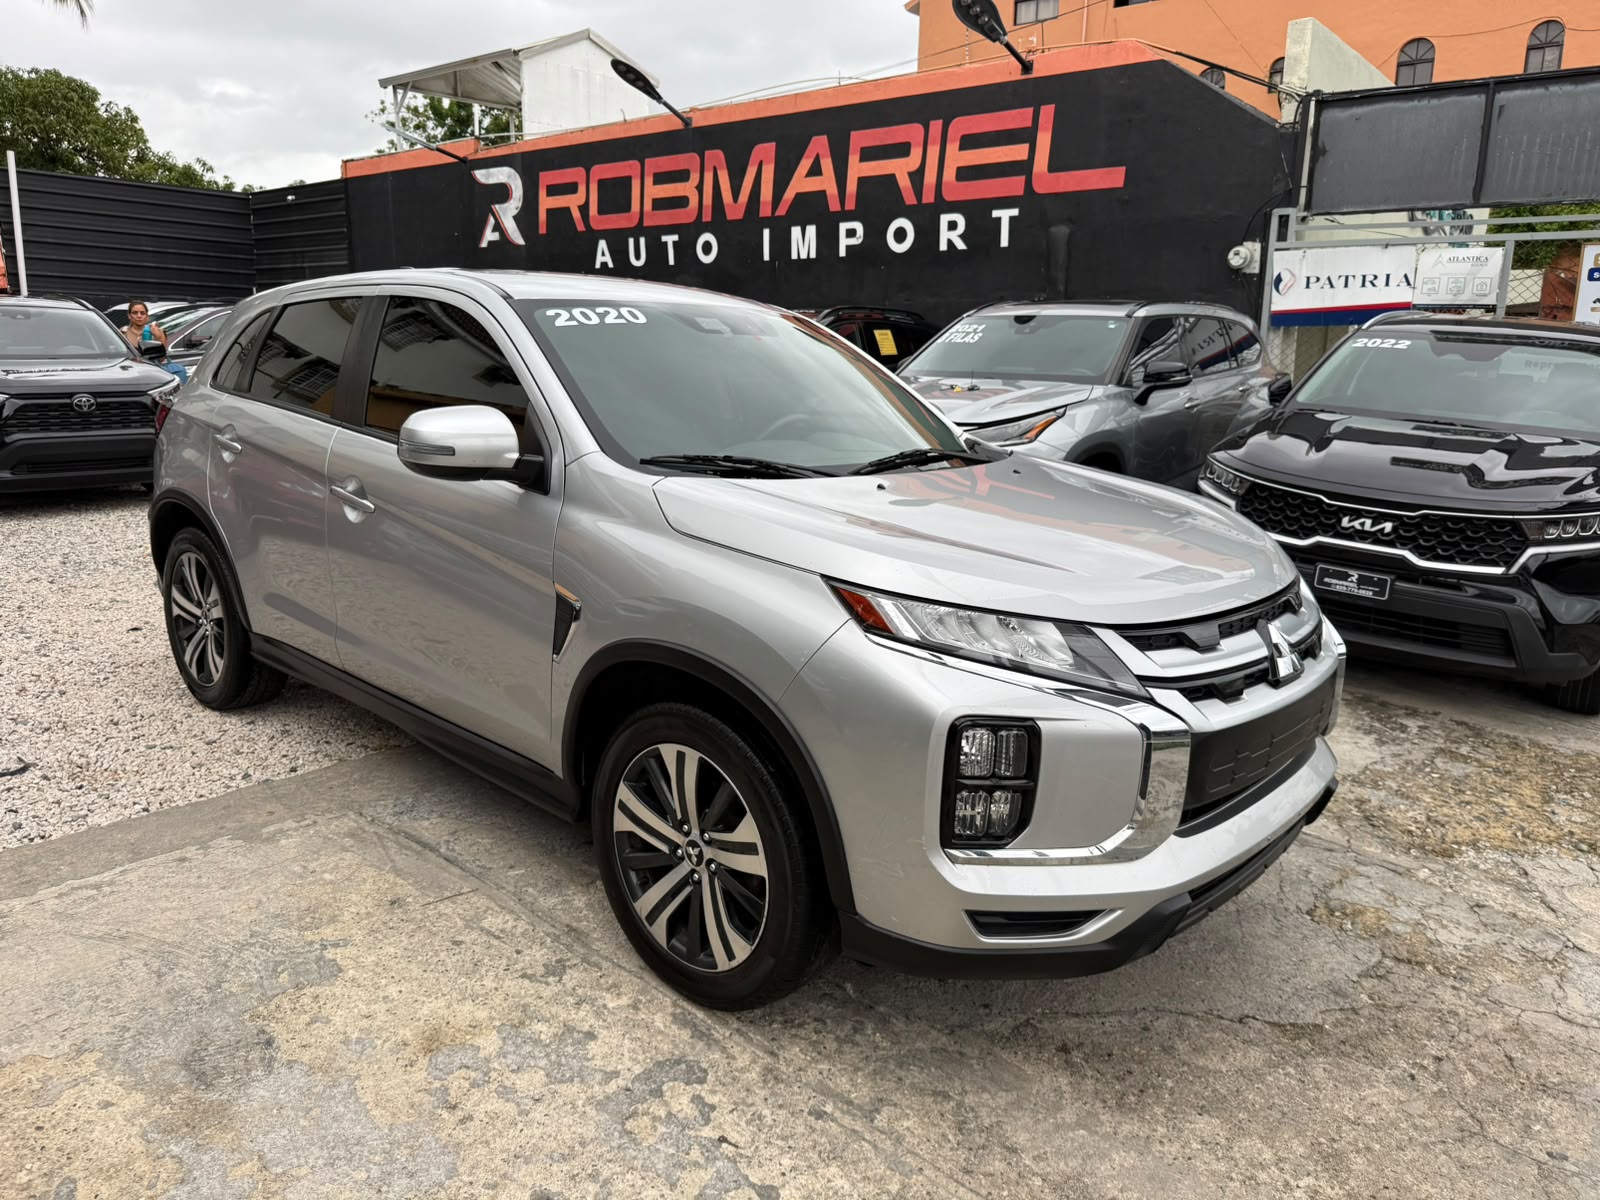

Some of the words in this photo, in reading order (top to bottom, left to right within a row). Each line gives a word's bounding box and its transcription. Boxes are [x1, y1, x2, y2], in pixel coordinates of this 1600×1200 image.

[538, 104, 1127, 235] ROBMARIEL
[594, 231, 719, 269] AUTO
[762, 207, 1020, 262] IMPORT
[1304, 273, 1413, 289] PATRIA
[546, 306, 648, 327] 2020
[1351, 338, 1412, 349] 2022
[1341, 515, 1393, 533] KIA
